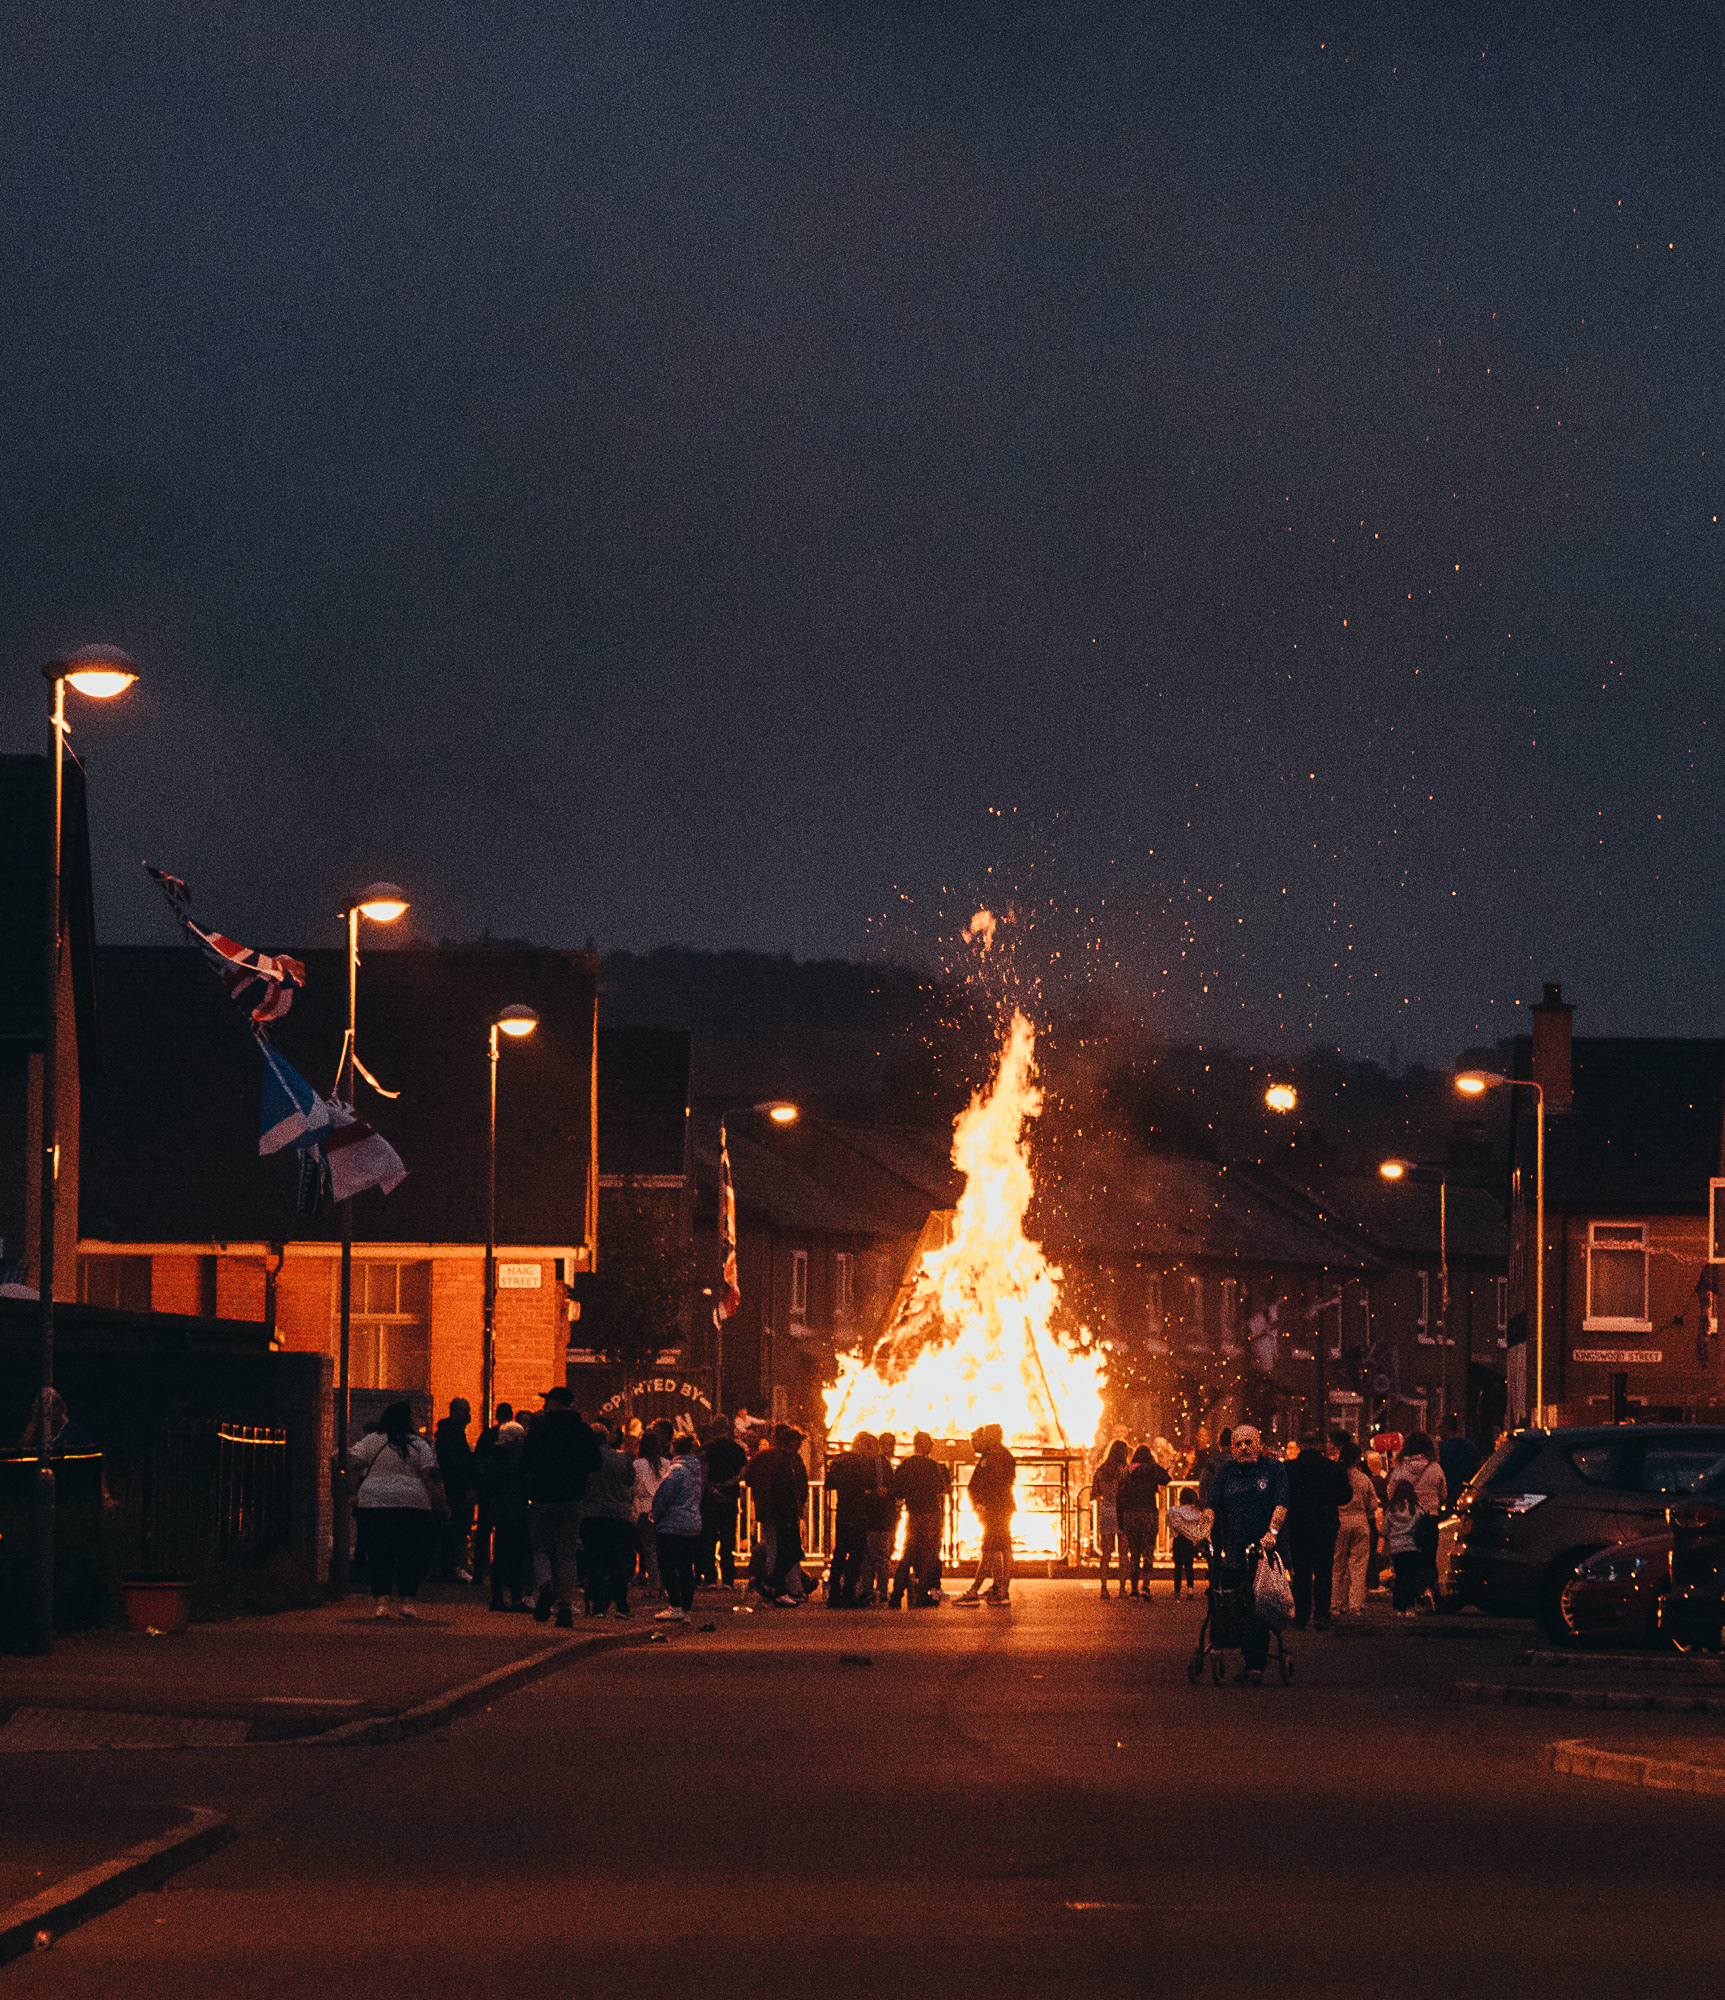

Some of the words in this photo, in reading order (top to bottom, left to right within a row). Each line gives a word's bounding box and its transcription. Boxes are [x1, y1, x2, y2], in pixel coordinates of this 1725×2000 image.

[507, 1266, 534, 1276] HAIG
[500, 1276, 540, 1286] STREET
[1628, 1351, 1660, 1361] STREET
[680, 1381, 704, 1401] BY
